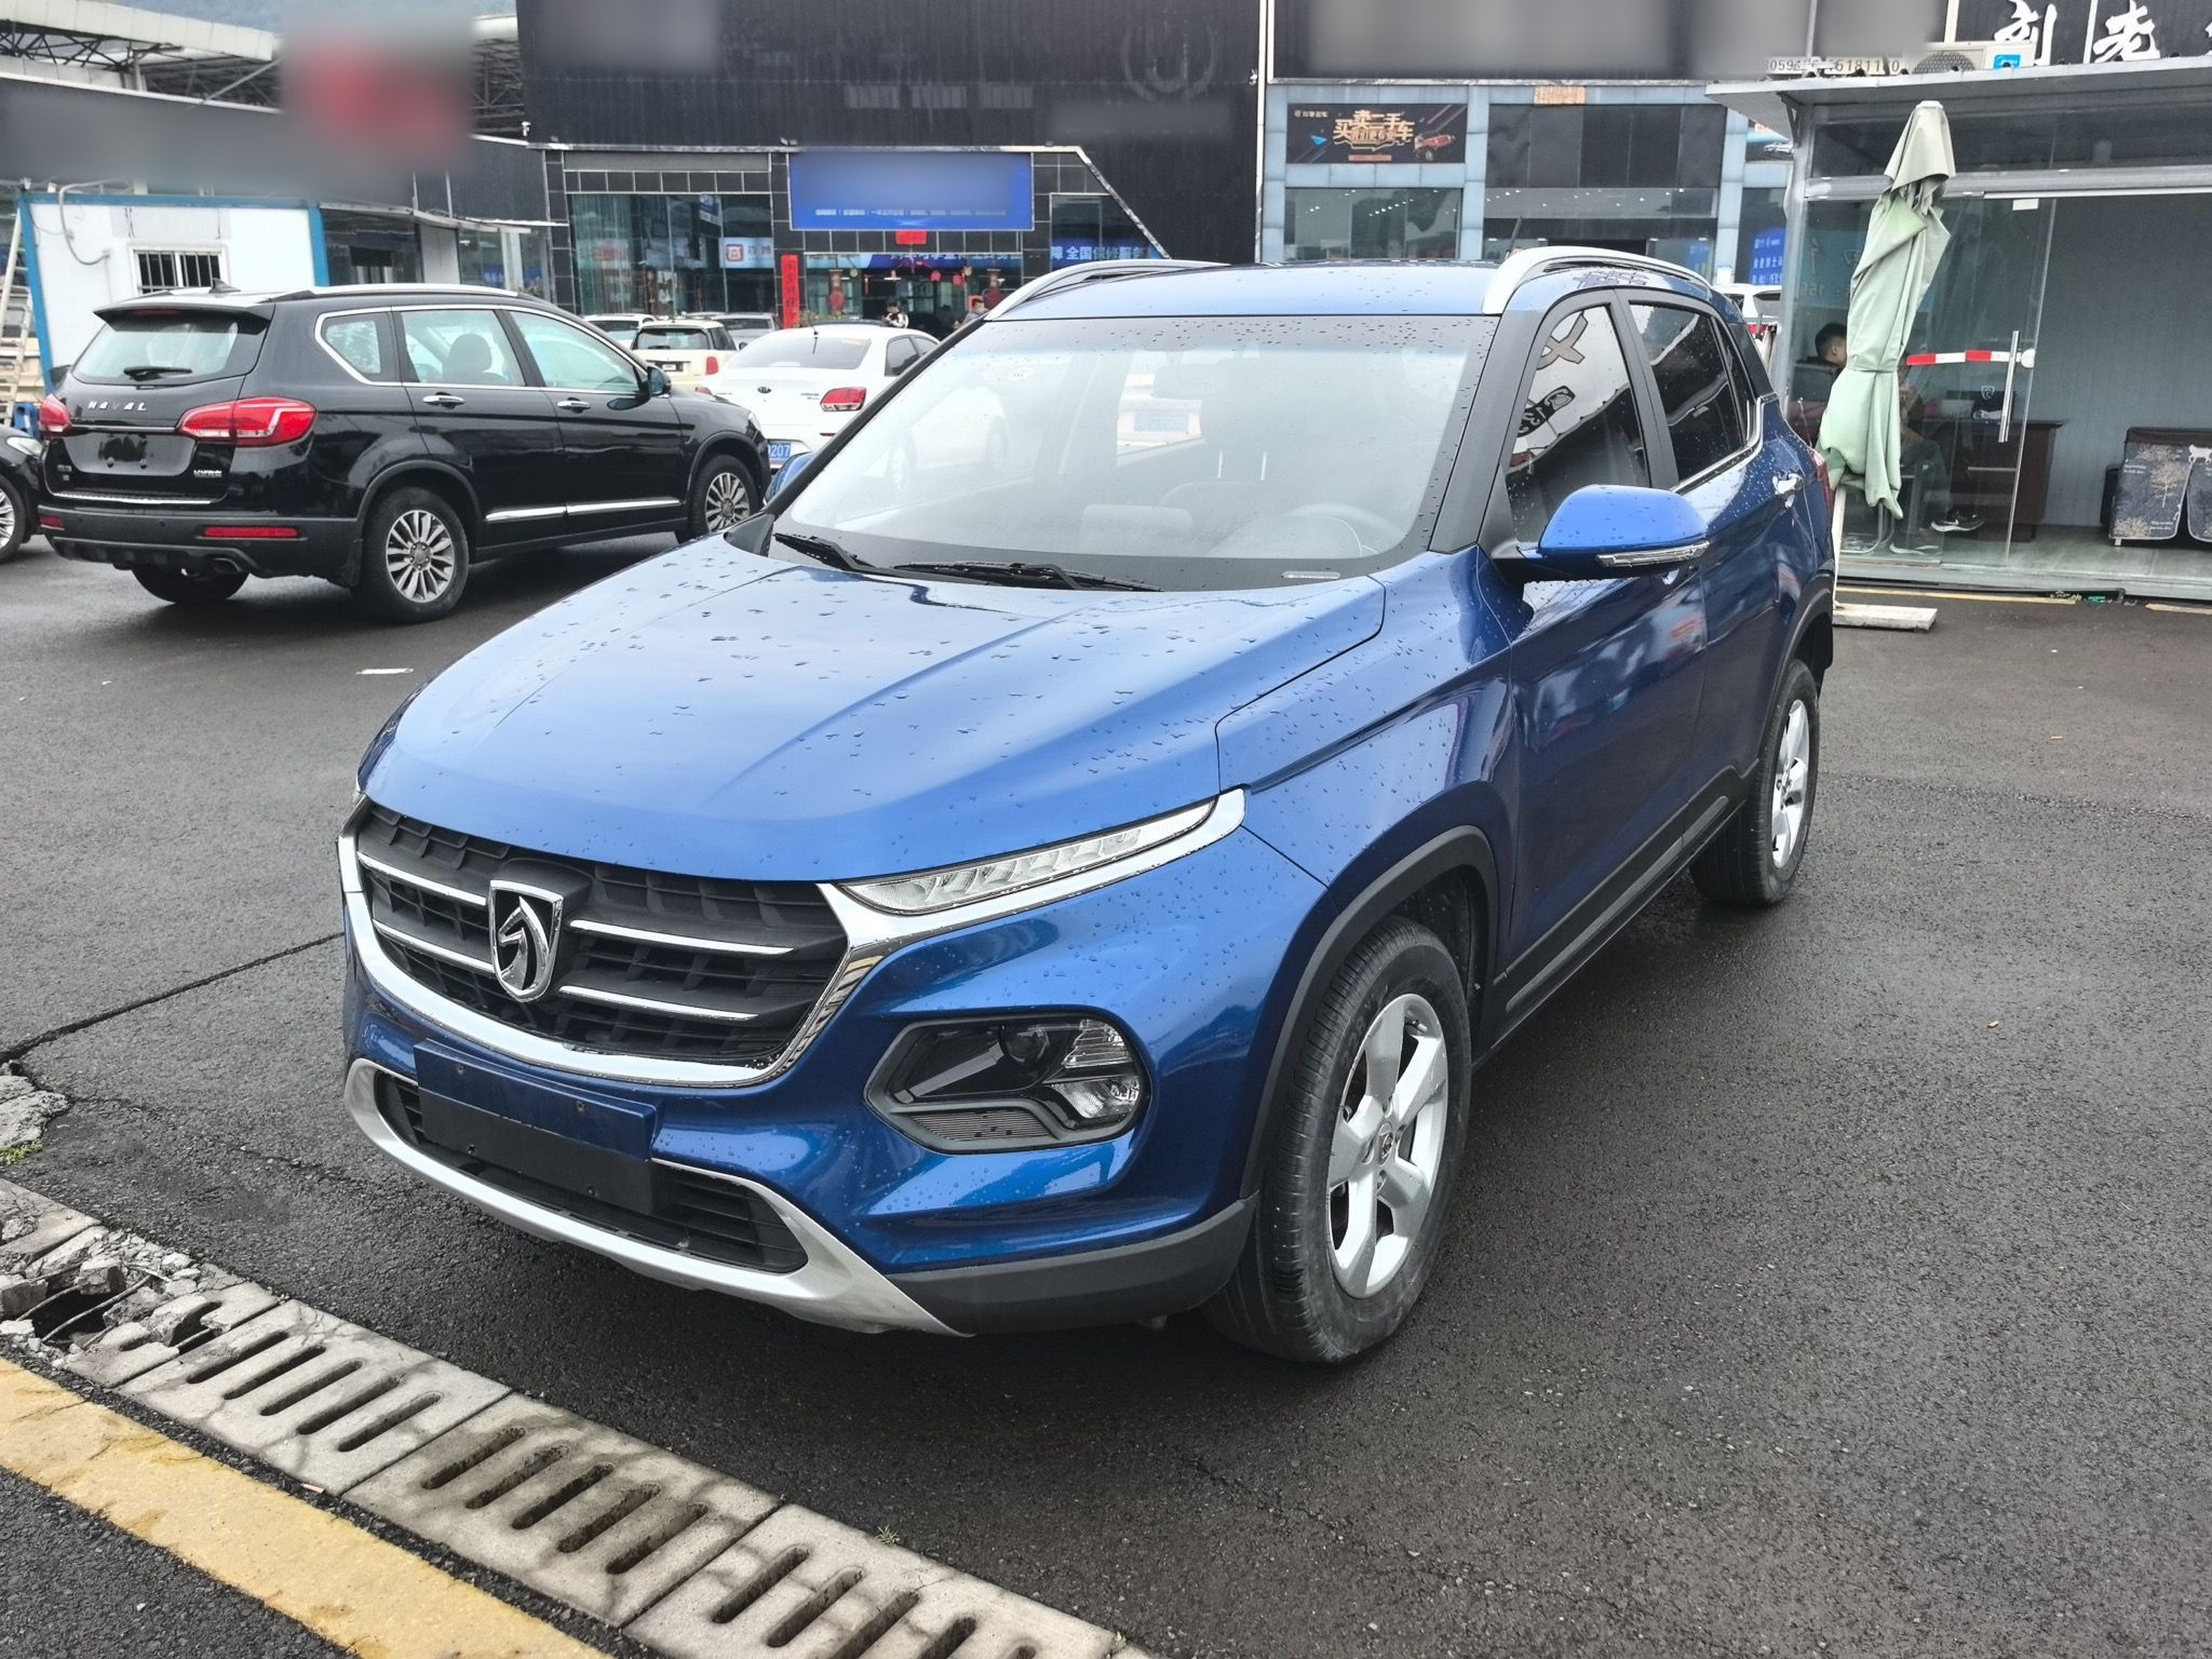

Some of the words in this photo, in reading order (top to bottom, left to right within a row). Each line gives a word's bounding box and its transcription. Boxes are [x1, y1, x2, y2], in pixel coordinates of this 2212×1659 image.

[1332, 109, 1415, 141] 买卖二手车
[88, 401, 146, 411] HAVAL
